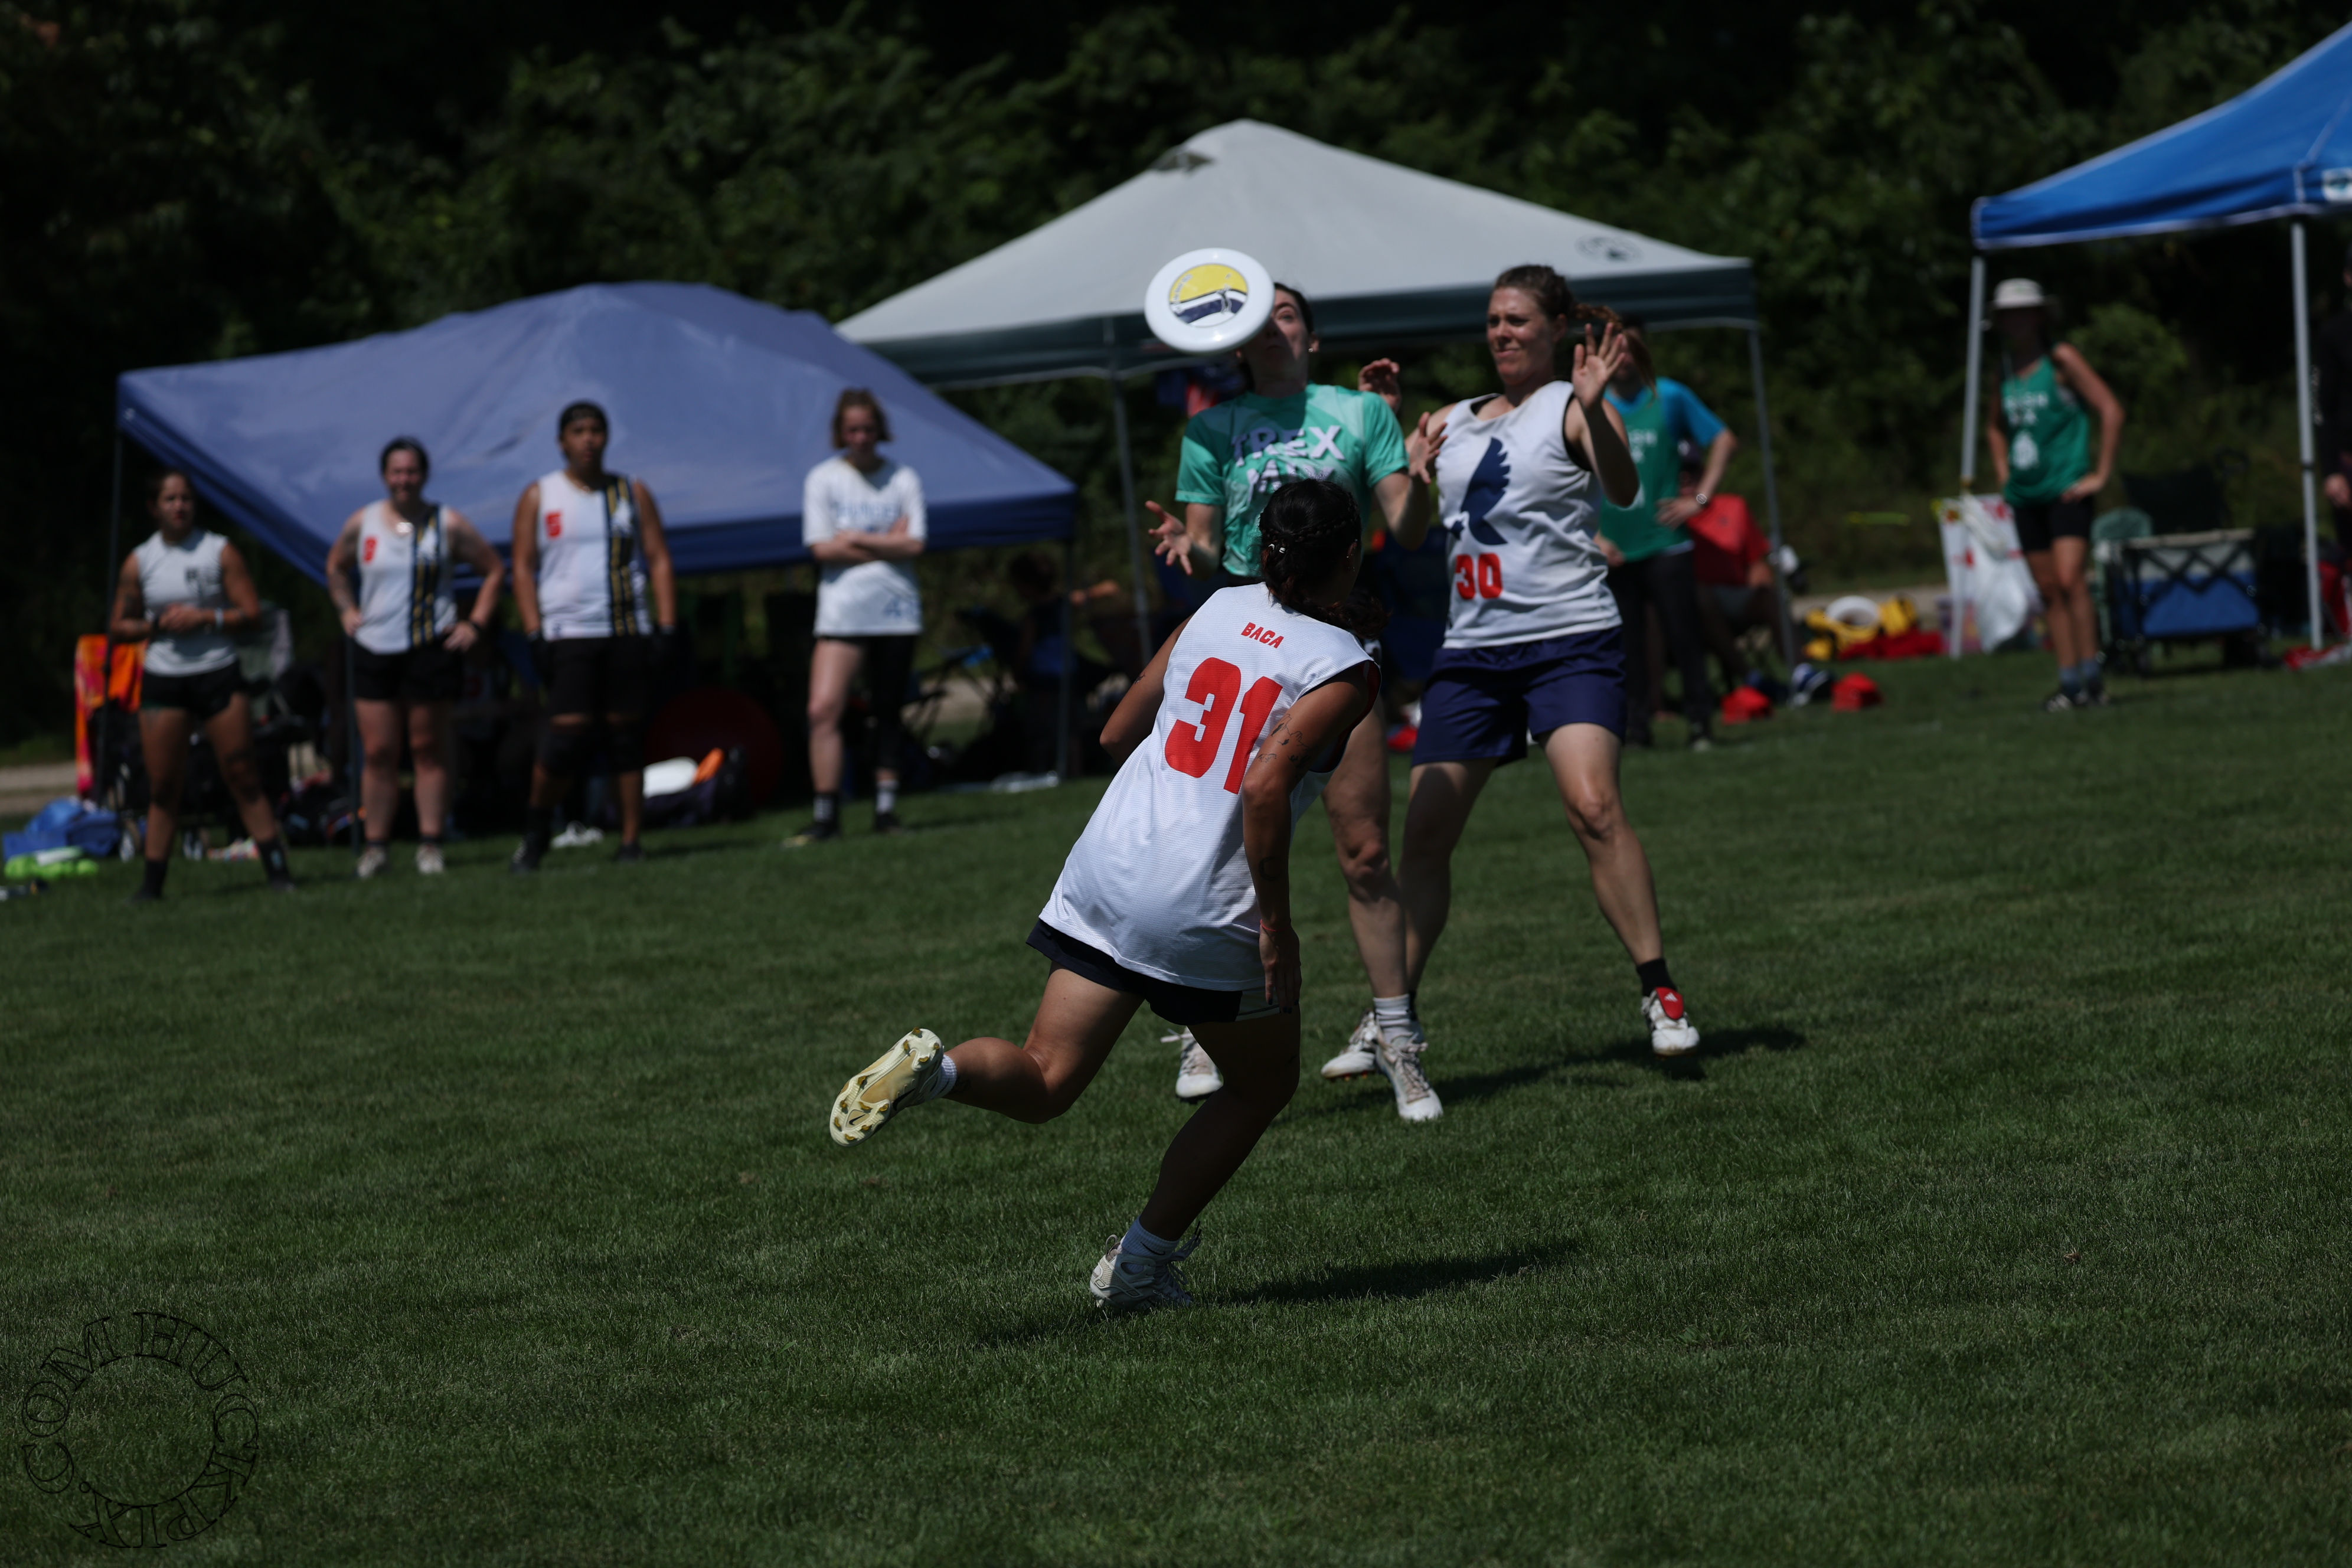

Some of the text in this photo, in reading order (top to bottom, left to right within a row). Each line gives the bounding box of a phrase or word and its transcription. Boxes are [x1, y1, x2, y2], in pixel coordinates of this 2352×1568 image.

[1232, 424, 1346, 467] TREX
[1455, 553, 1502, 599] 30
[1241, 622, 1284, 648] BACA
[1165, 657, 1283, 795] 31
